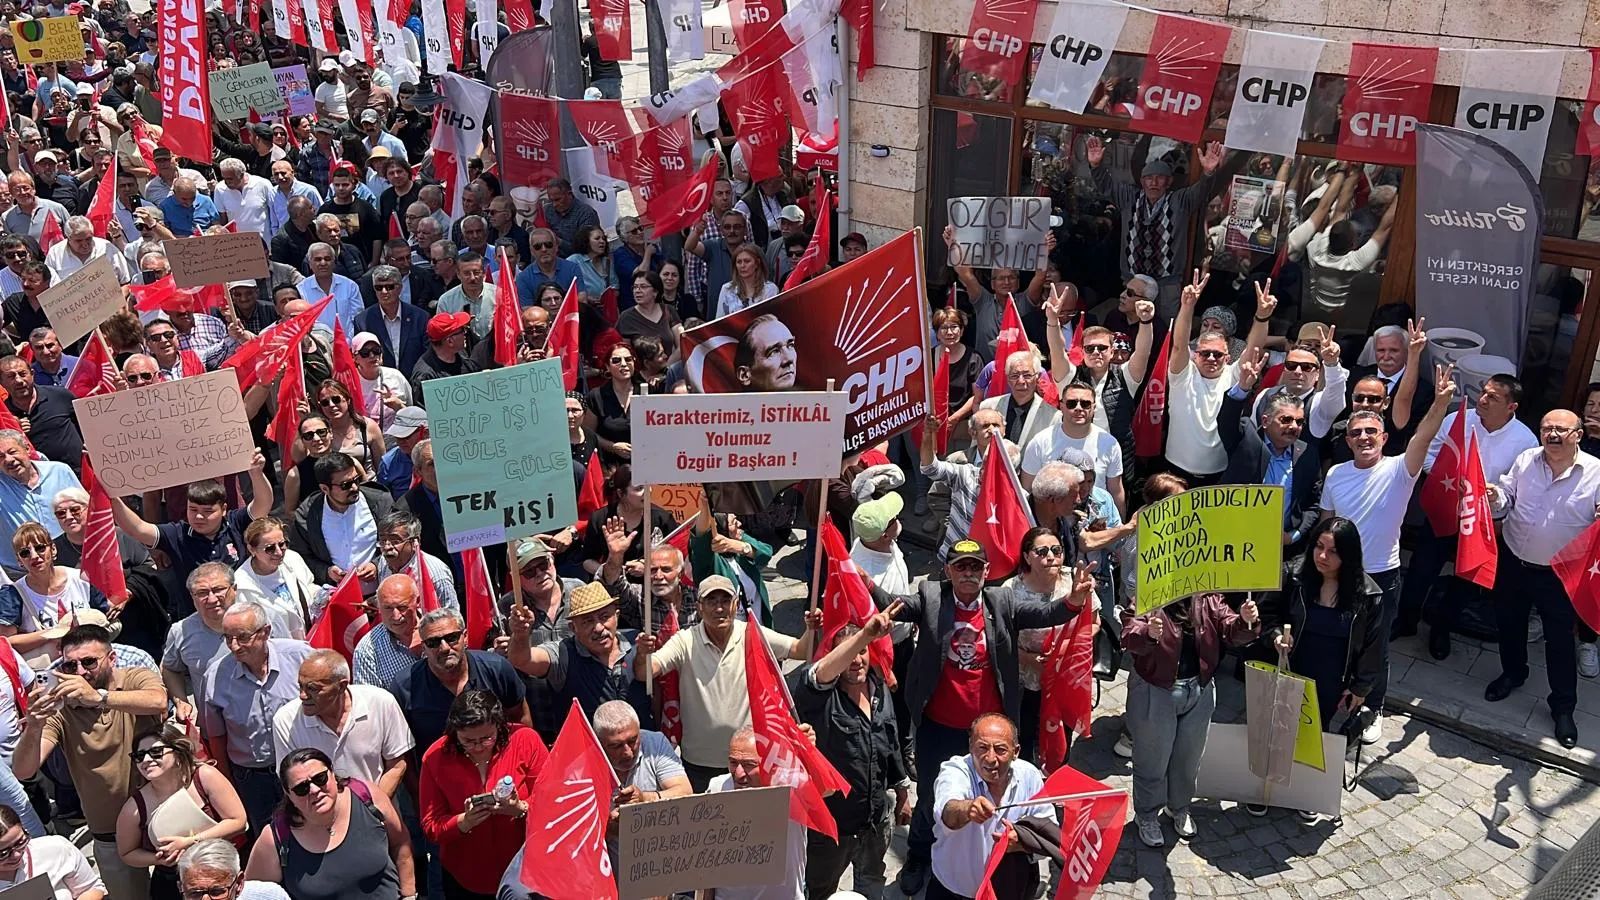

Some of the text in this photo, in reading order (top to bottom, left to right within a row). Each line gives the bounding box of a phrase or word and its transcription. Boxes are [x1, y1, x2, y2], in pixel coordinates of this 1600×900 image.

[972, 28, 1022, 58] CHP
[1050, 34, 1103, 66] CHP
[1144, 86, 1202, 116] CHP
[1242, 77, 1308, 108] CHP
[1350, 112, 1418, 138] CHP
[1466, 102, 1545, 131] CHP
[434, 367, 562, 412] YÖNETİM
[842, 346, 922, 414] CHP
[88, 378, 218, 418] BİZ BİRLİKTE
[120, 395, 212, 427] GÜÇLÜYÜZ
[854, 392, 908, 428] YENİFAKILI
[182, 418, 210, 434] BİZ
[434, 398, 538, 439] EKİP İŞİ
[646, 403, 831, 426] Karakterimiz, İSTİKLÂL
[868, 402, 926, 440] BAŞKANLIĞI
[442, 439, 507, 465] GÜLE
[706, 432, 771, 446] Yolumuz
[102, 445, 169, 466] AYDINLIK
[504, 452, 568, 482] GÜLE
[677, 452, 798, 472] Özgür Başkan !
[446, 490, 497, 514] TEK
[504, 494, 554, 528] KİŞİ
[1154, 512, 1202, 540] YOLDA
[1140, 528, 1208, 564] YANINDA
[633, 831, 700, 858] HALKIN
[630, 854, 693, 882] HALKIN
